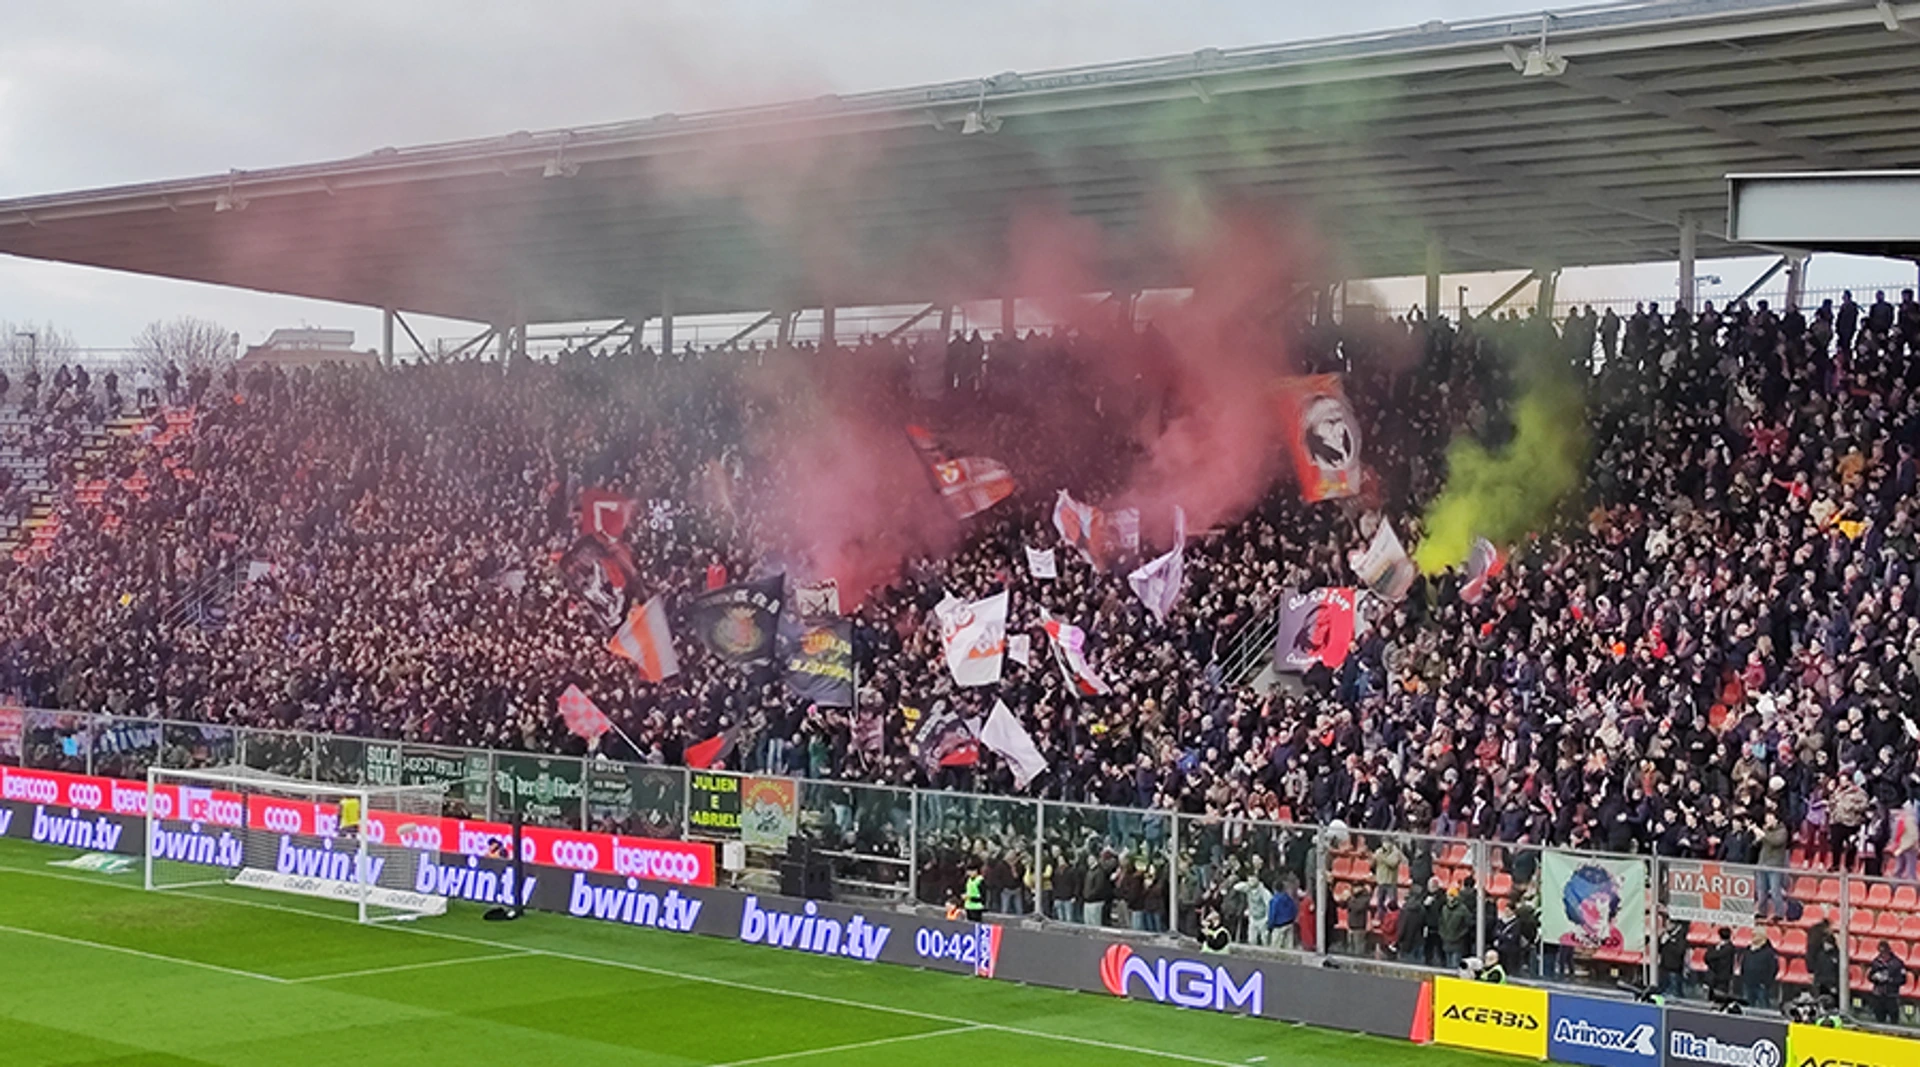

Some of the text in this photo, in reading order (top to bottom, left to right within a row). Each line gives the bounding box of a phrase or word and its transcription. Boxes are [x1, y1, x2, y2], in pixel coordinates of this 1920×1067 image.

[693, 775, 737, 792] JULIEN
[711, 795, 719, 809] E
[3, 767, 59, 803] ipercoop
[69, 783, 102, 810] coop
[264, 806, 302, 833] coop
[552, 840, 599, 870] coop
[612, 837, 700, 884] ipercoop
[691, 811, 742, 827] ABRIELE
[33, 804, 122, 851] bwin.tv
[152, 819, 242, 867] bwin.tv
[569, 872, 702, 931] bwin.tv
[741, 896, 891, 960] bwin.tv
[1674, 872, 1750, 897] MARIO
[917, 928, 976, 962] 00:42
[1121, 955, 1263, 1016] NGM
[1555, 1018, 1624, 1050] Arinox
[1671, 1031, 1754, 1066] iltainox
